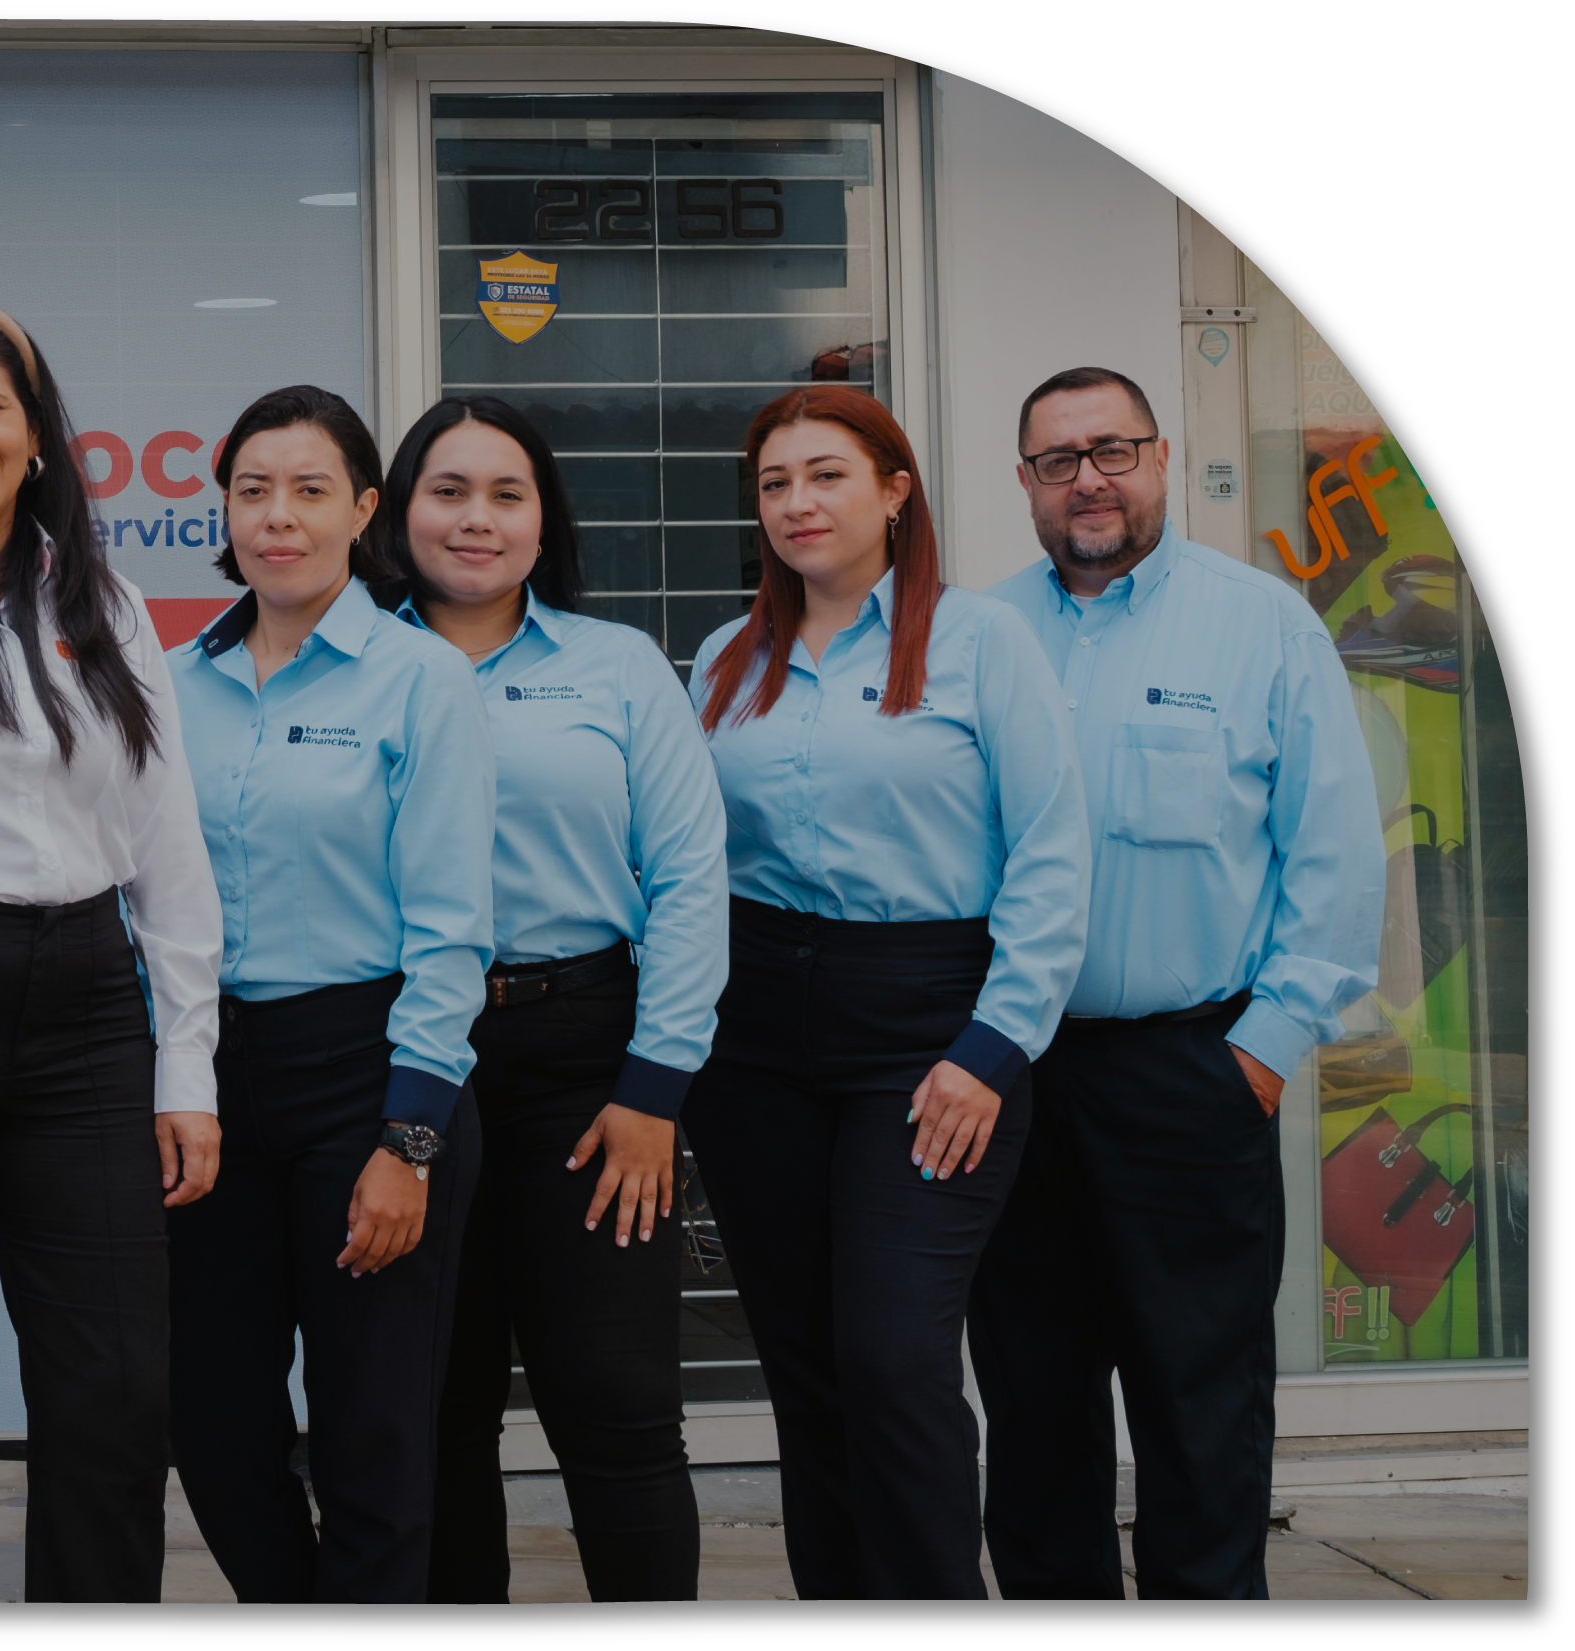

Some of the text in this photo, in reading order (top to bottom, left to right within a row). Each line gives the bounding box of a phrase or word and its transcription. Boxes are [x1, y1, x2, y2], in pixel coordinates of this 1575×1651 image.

[507, 285, 550, 295] ESTATAL
[539, 685, 574, 694] ayuda
[523, 693, 582, 701] financiera
[1164, 688, 1211, 702] tu ayuda
[1161, 697, 1217, 713] financiera
[305, 726, 356, 736] tu ayuda
[302, 736, 361, 748] financiera
